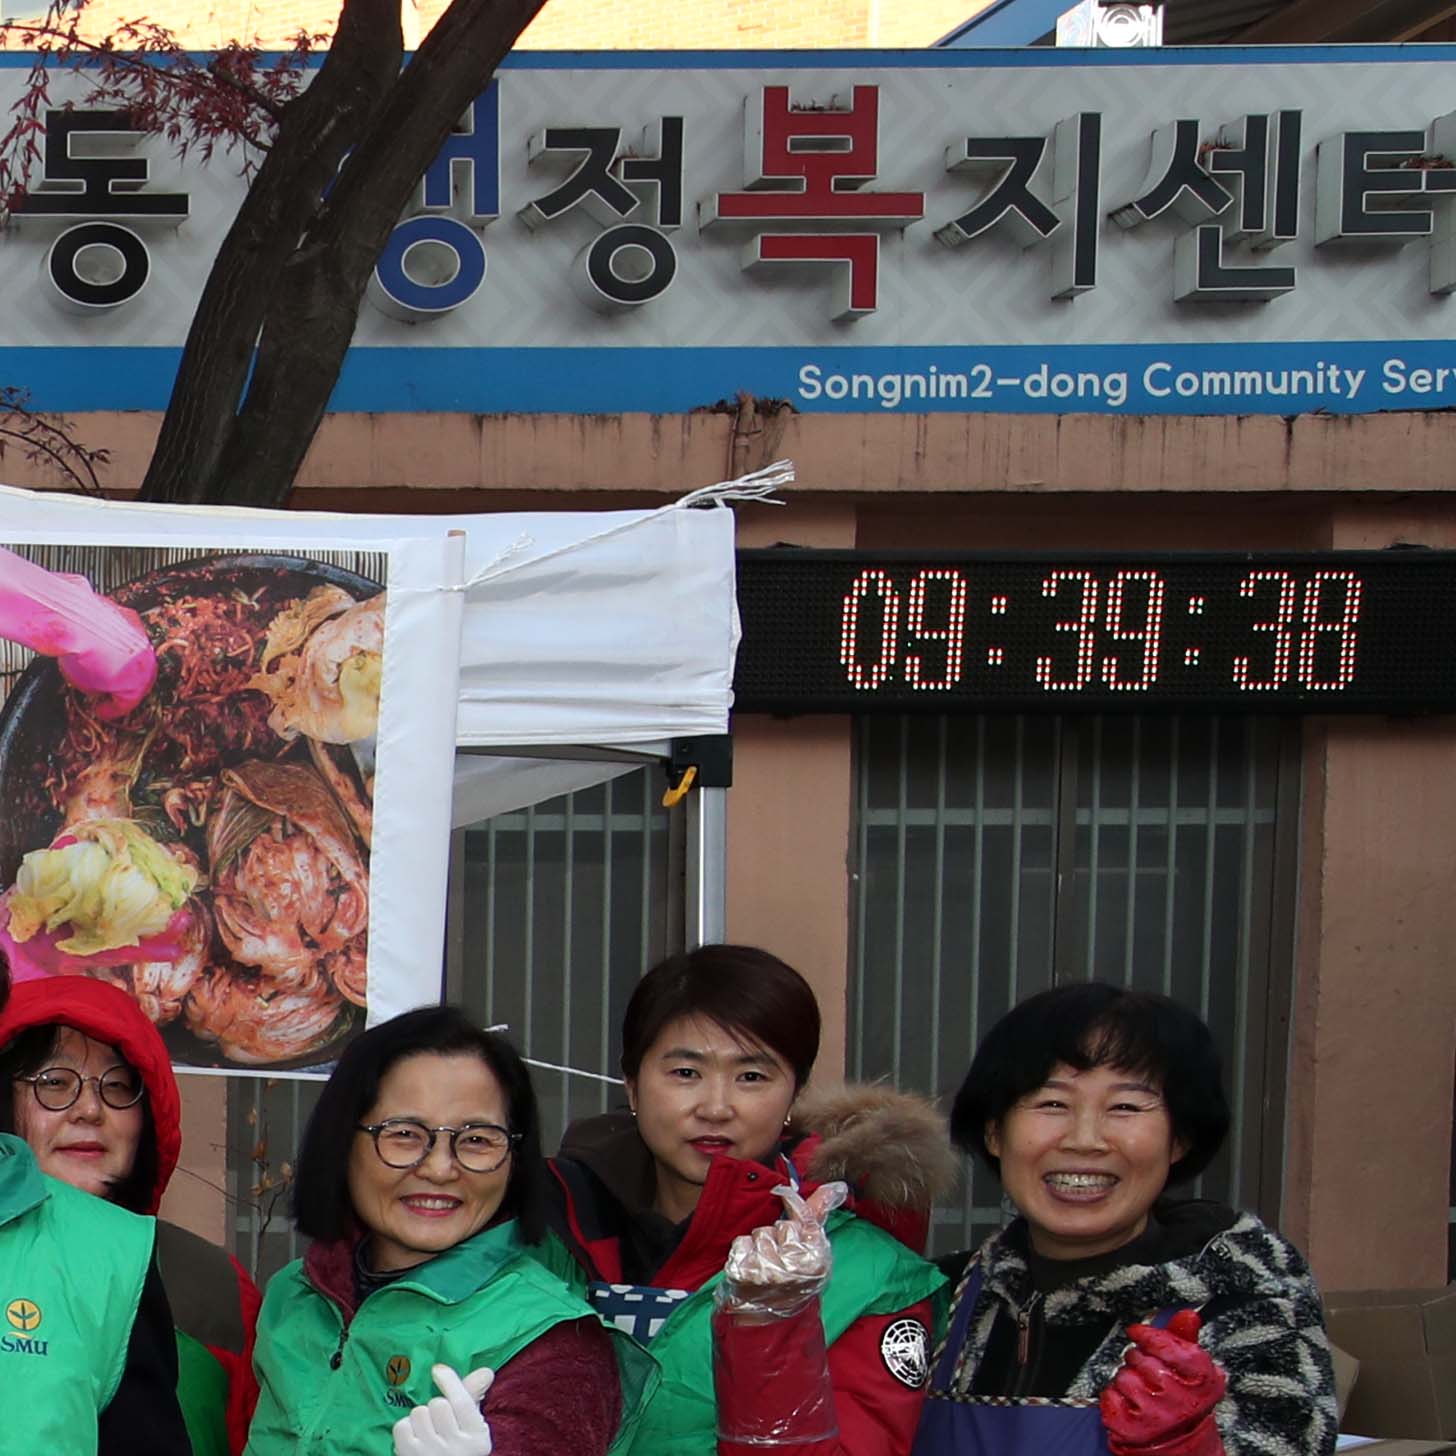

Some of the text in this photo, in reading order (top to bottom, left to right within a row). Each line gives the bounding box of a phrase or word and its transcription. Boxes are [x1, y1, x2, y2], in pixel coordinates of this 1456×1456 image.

[798, 359, 1456, 407] Songnim2-dong Community Ser
[839, 569, 1363, 693] 09:39:38
[0, 1335, 48, 1356] SMU
